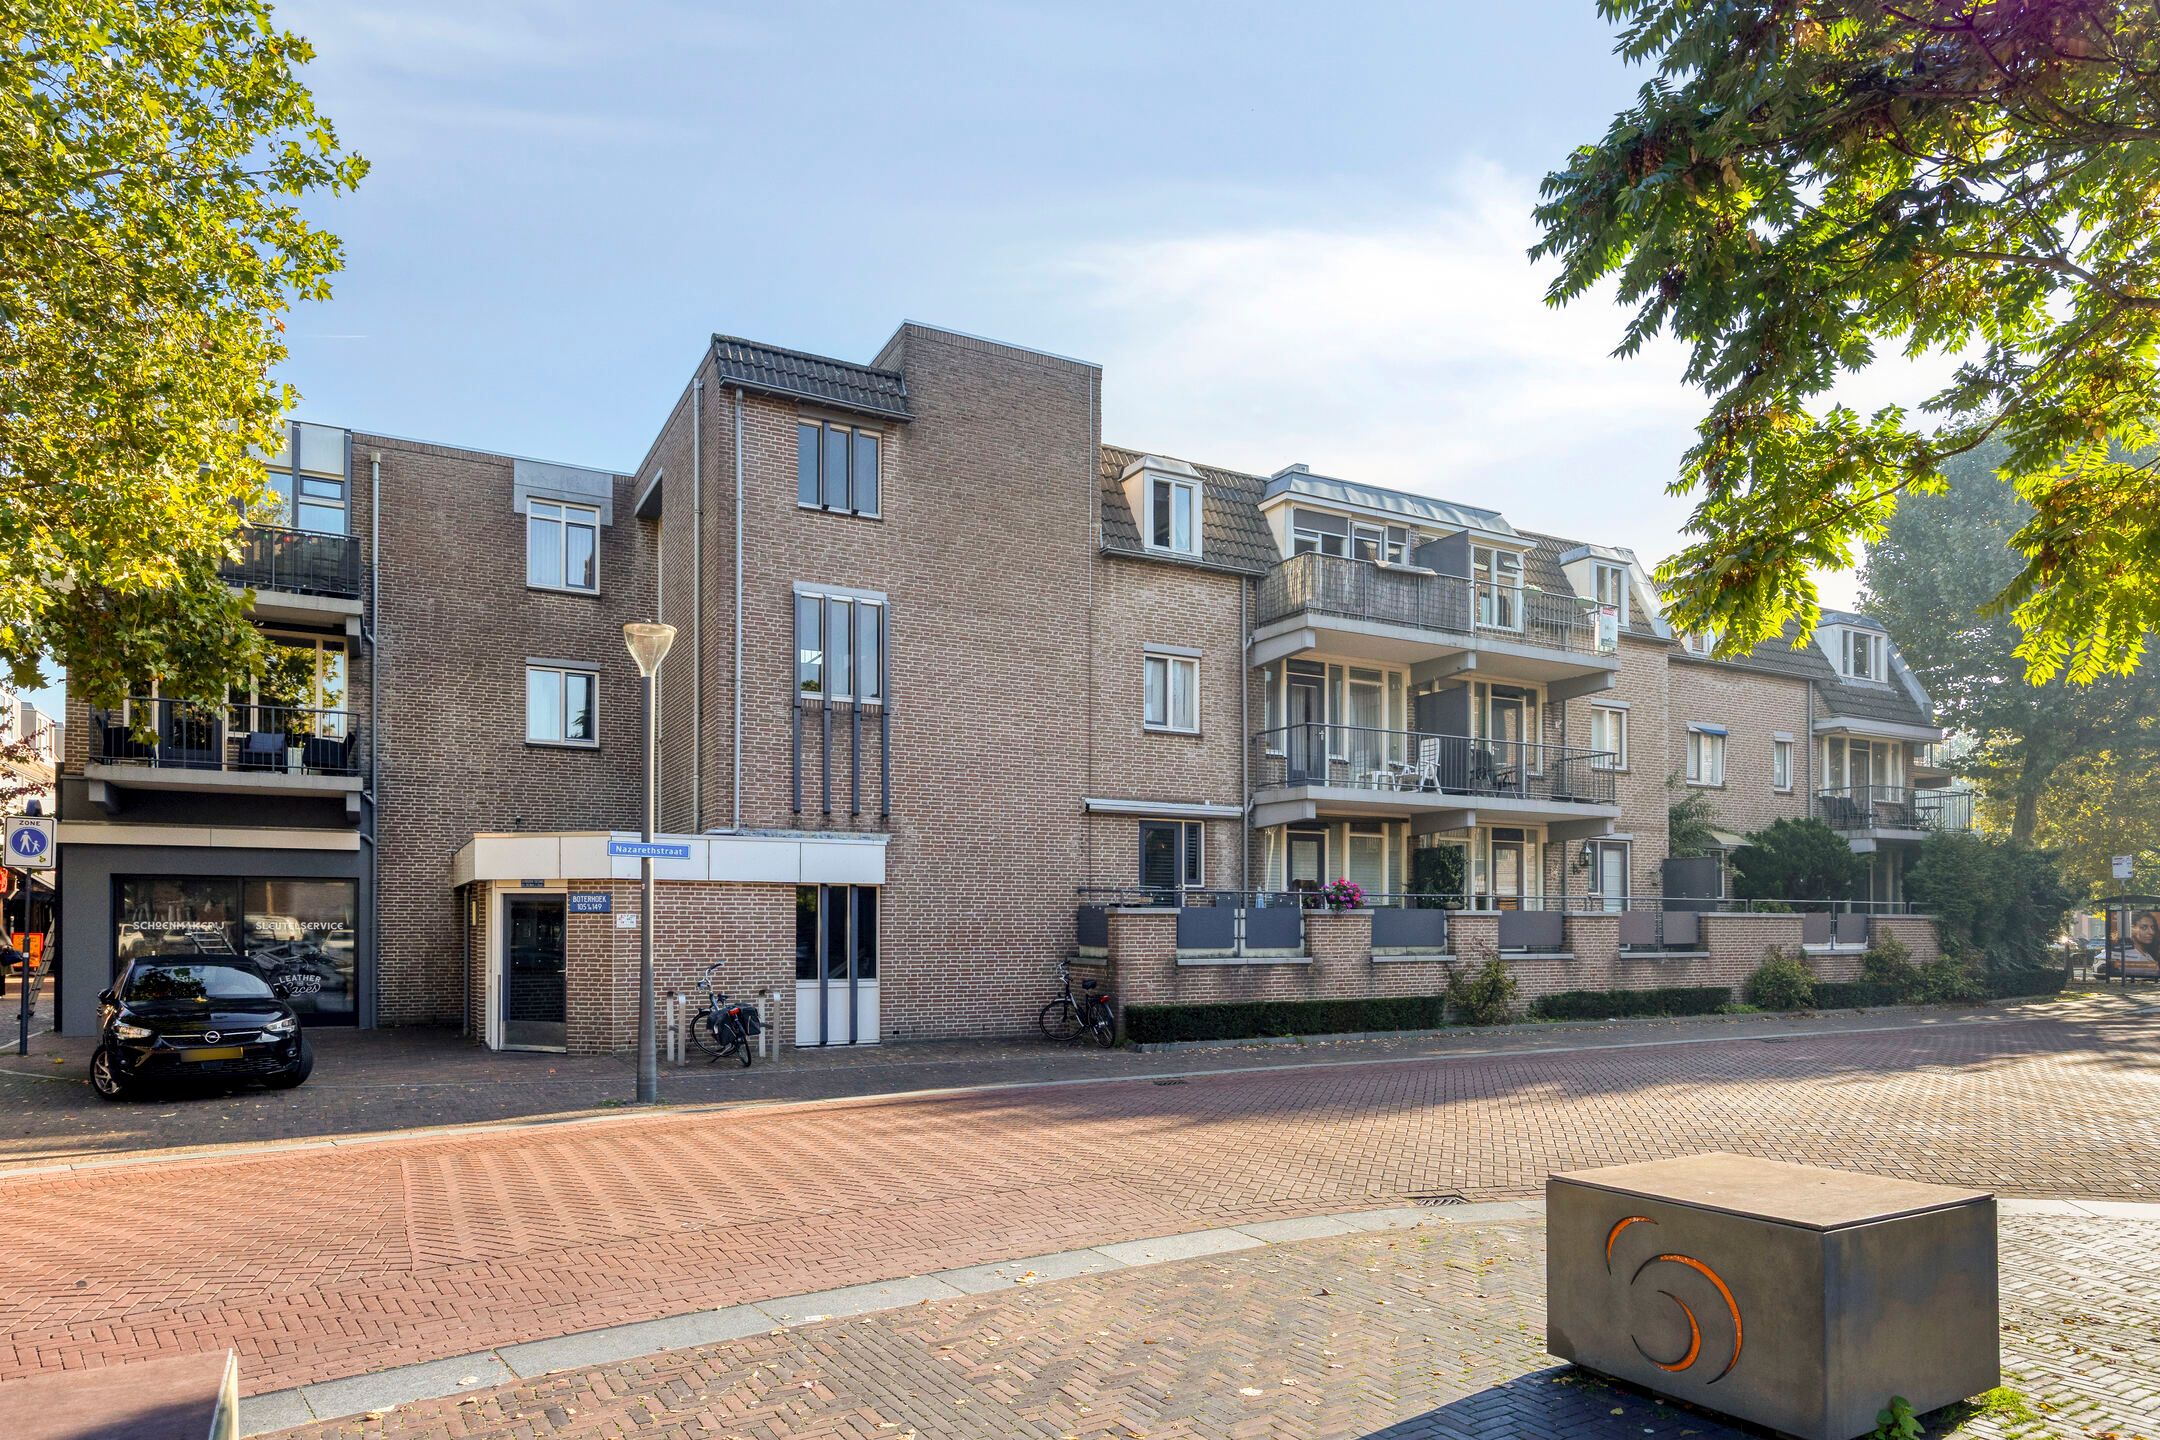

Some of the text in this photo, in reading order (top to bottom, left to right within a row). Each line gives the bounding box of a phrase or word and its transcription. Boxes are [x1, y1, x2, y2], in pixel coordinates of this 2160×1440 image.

[615, 845, 683, 855] Nazarethstraat
[572, 895, 607, 903] BOTERHOEK
[255, 922, 344, 930] SLEUTELSERVICE
[278, 974, 321, 983] LEATHER
